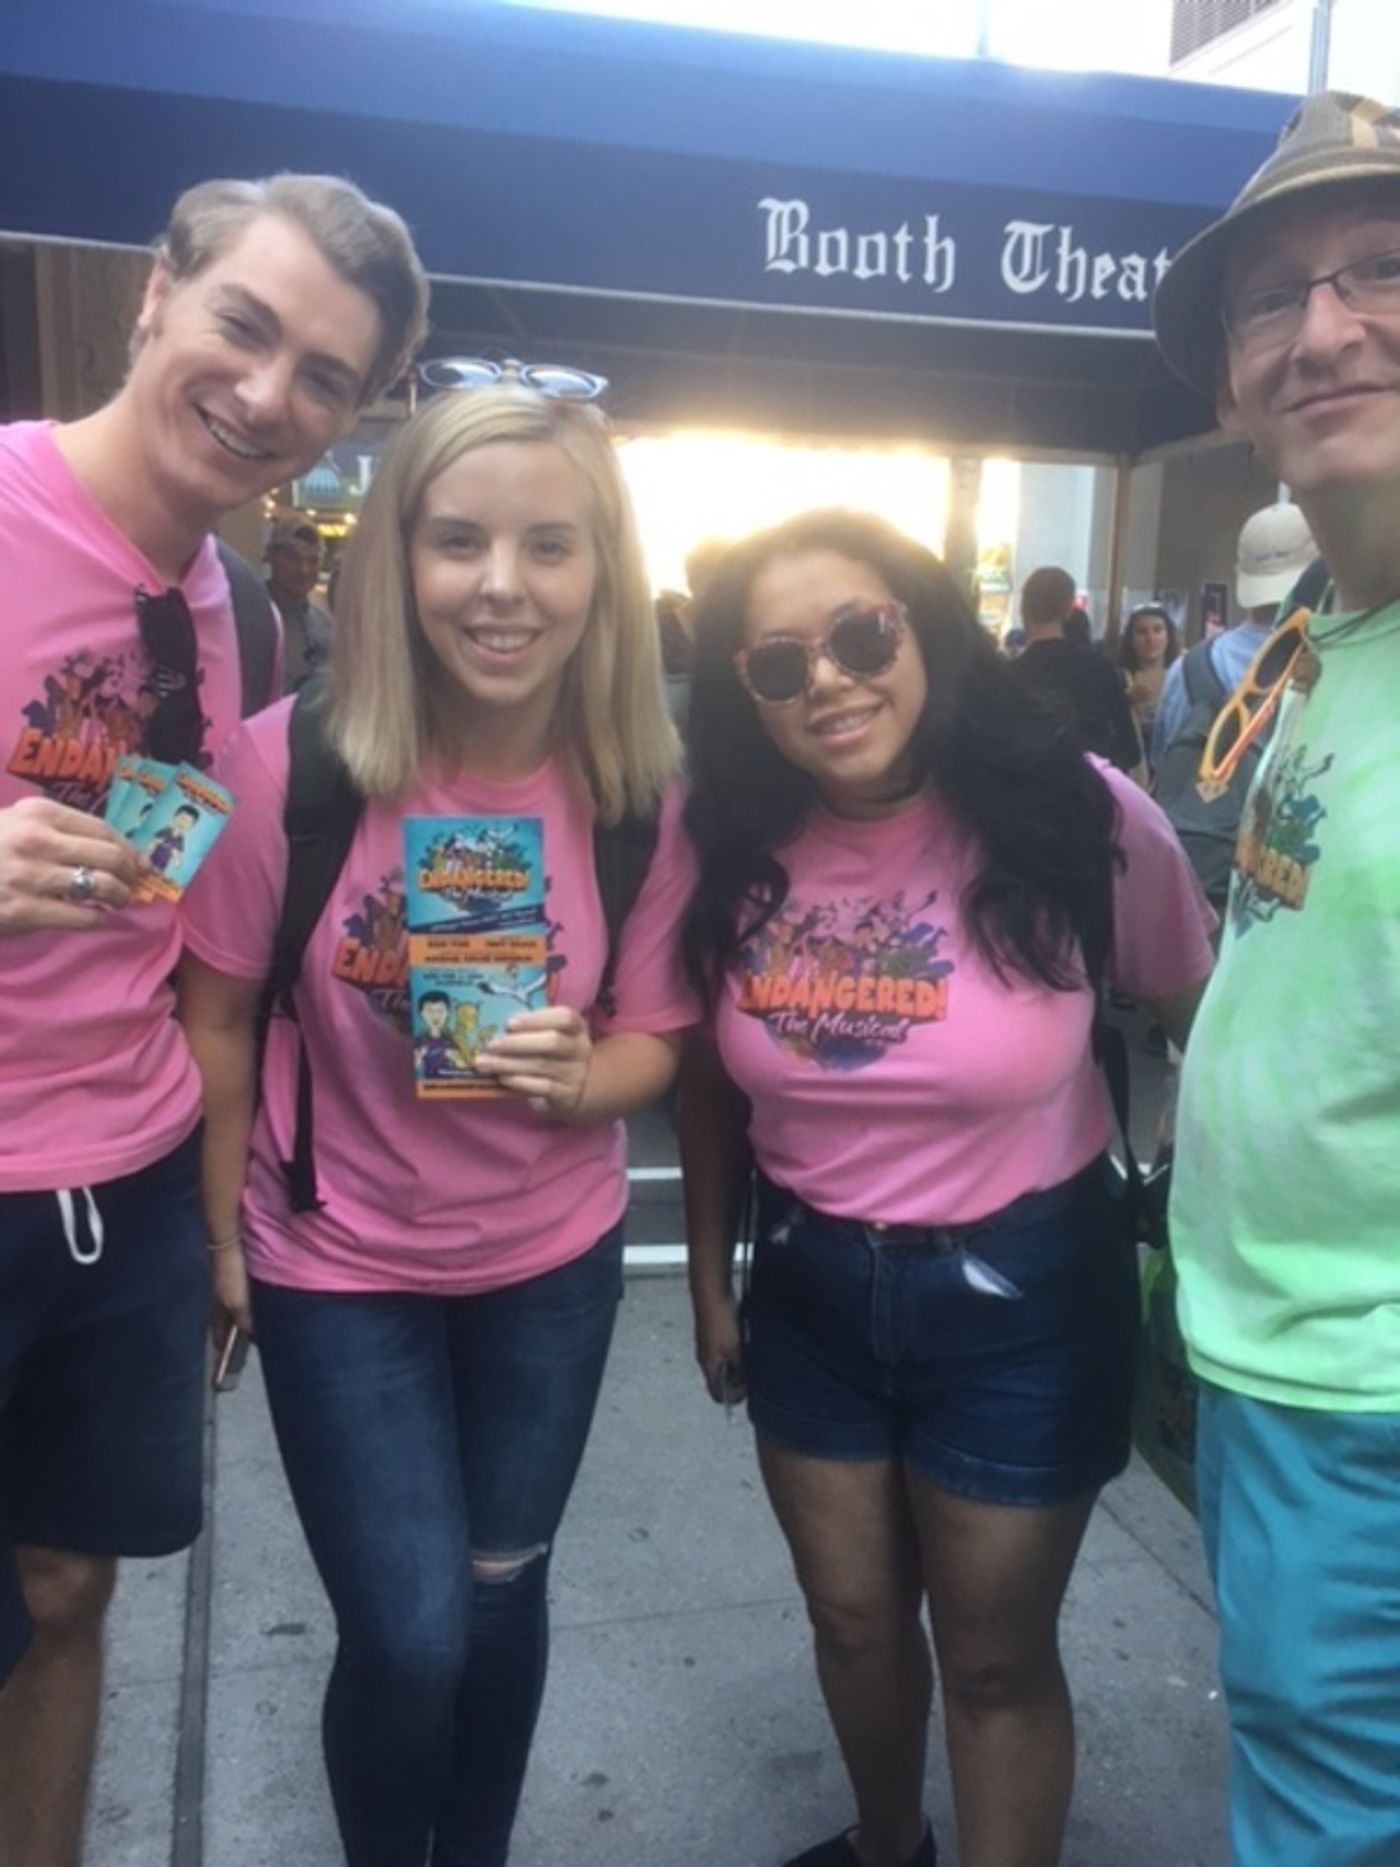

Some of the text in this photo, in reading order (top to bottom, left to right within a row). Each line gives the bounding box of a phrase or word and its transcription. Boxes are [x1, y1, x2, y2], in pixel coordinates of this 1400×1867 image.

[758, 197, 1172, 302] Booth Theat
[810, 1012, 910, 1042] Musical
